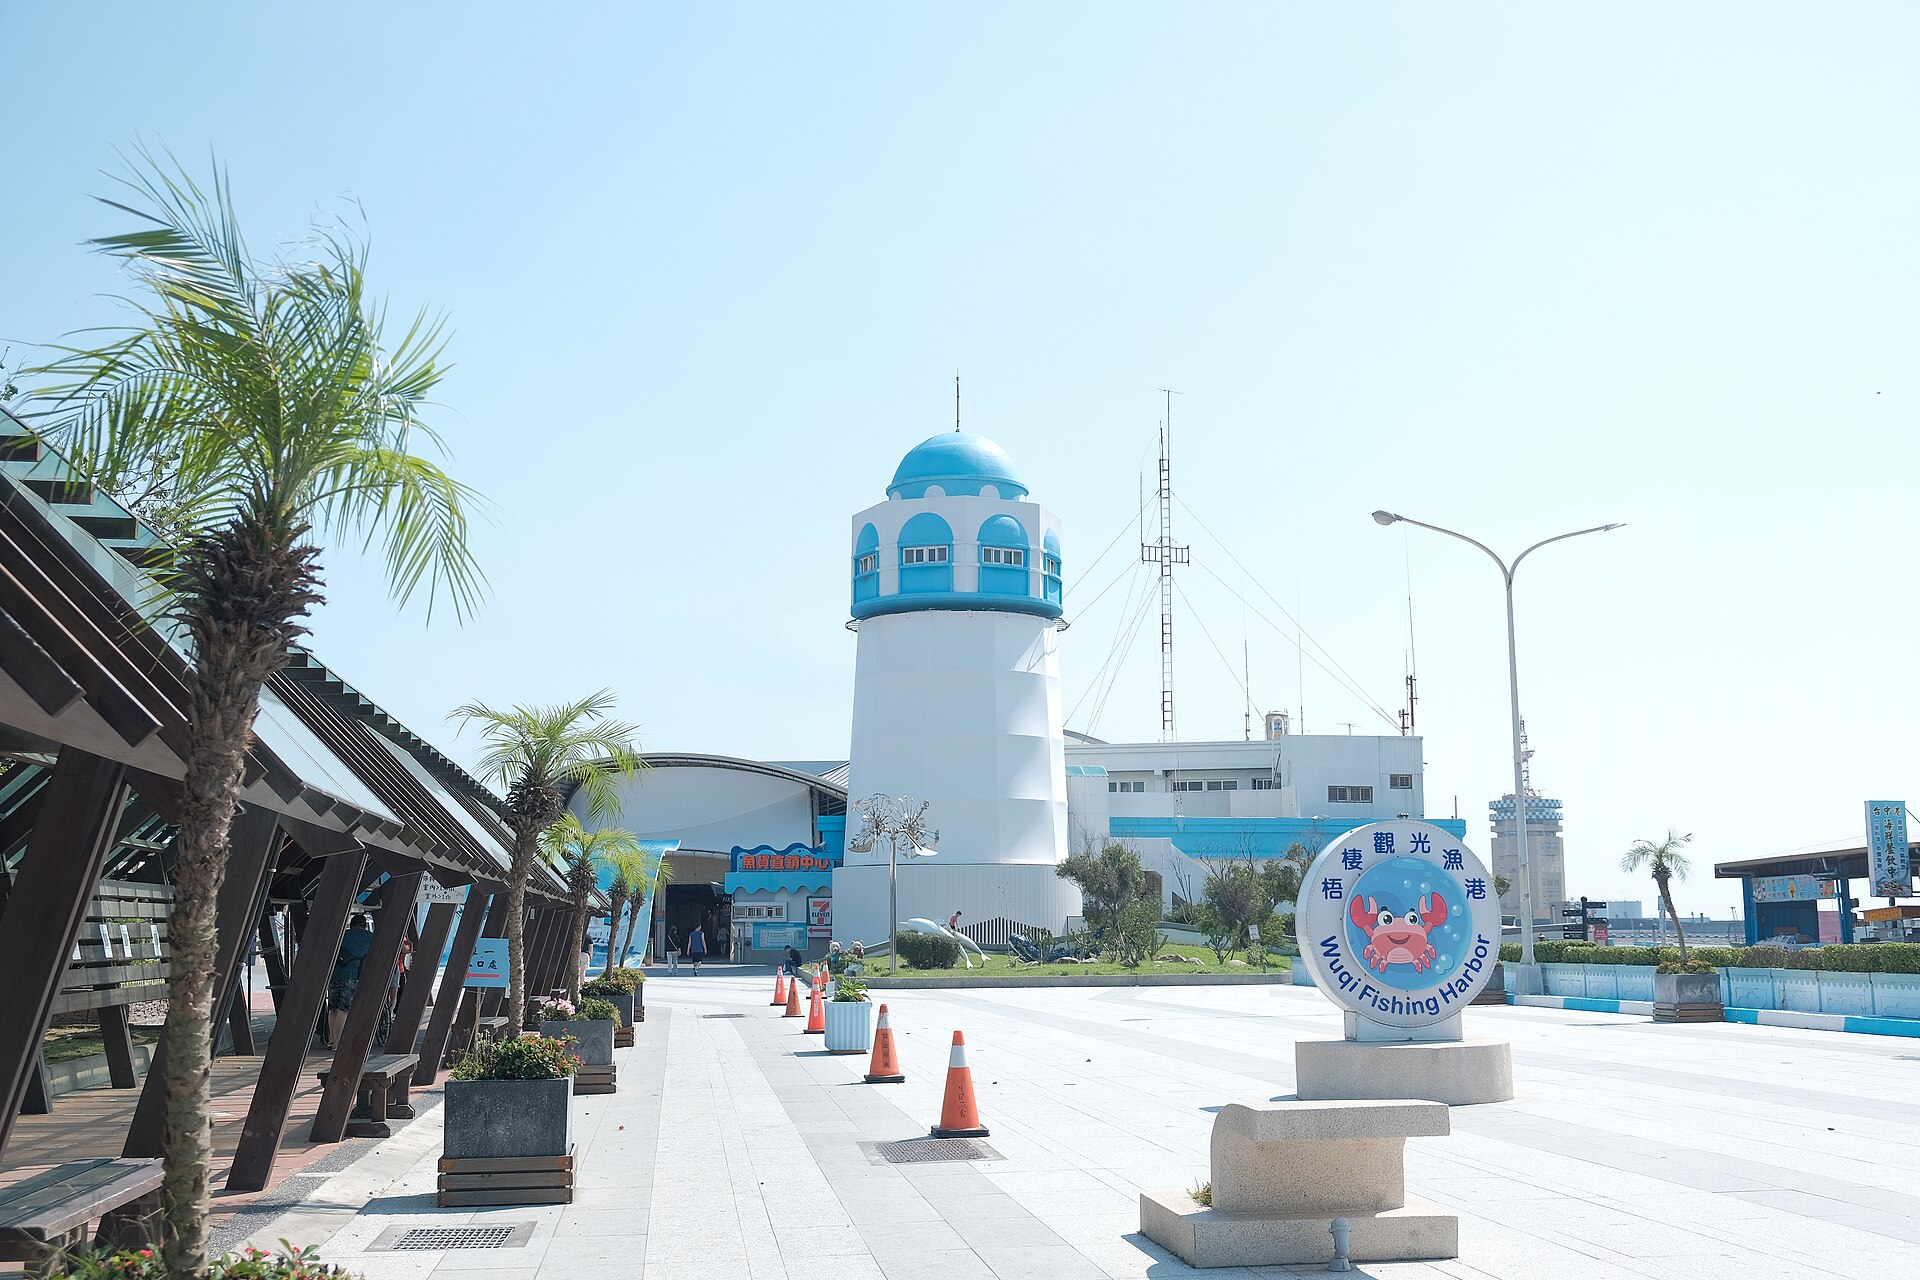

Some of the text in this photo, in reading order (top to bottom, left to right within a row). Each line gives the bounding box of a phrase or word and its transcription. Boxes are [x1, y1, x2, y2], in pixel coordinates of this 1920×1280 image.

[1873, 806, 1902, 817] 台中港
[742, 854, 829, 870] 魚貨直銷中心
[1321, 831, 1486, 900] 梧棲觀光漁港
[1884, 818, 1899, 890] 海鮮餐飲中心
[812, 901, 830, 925] 7
[1320, 933, 1491, 1016] Wuqi Fishing Harbor
